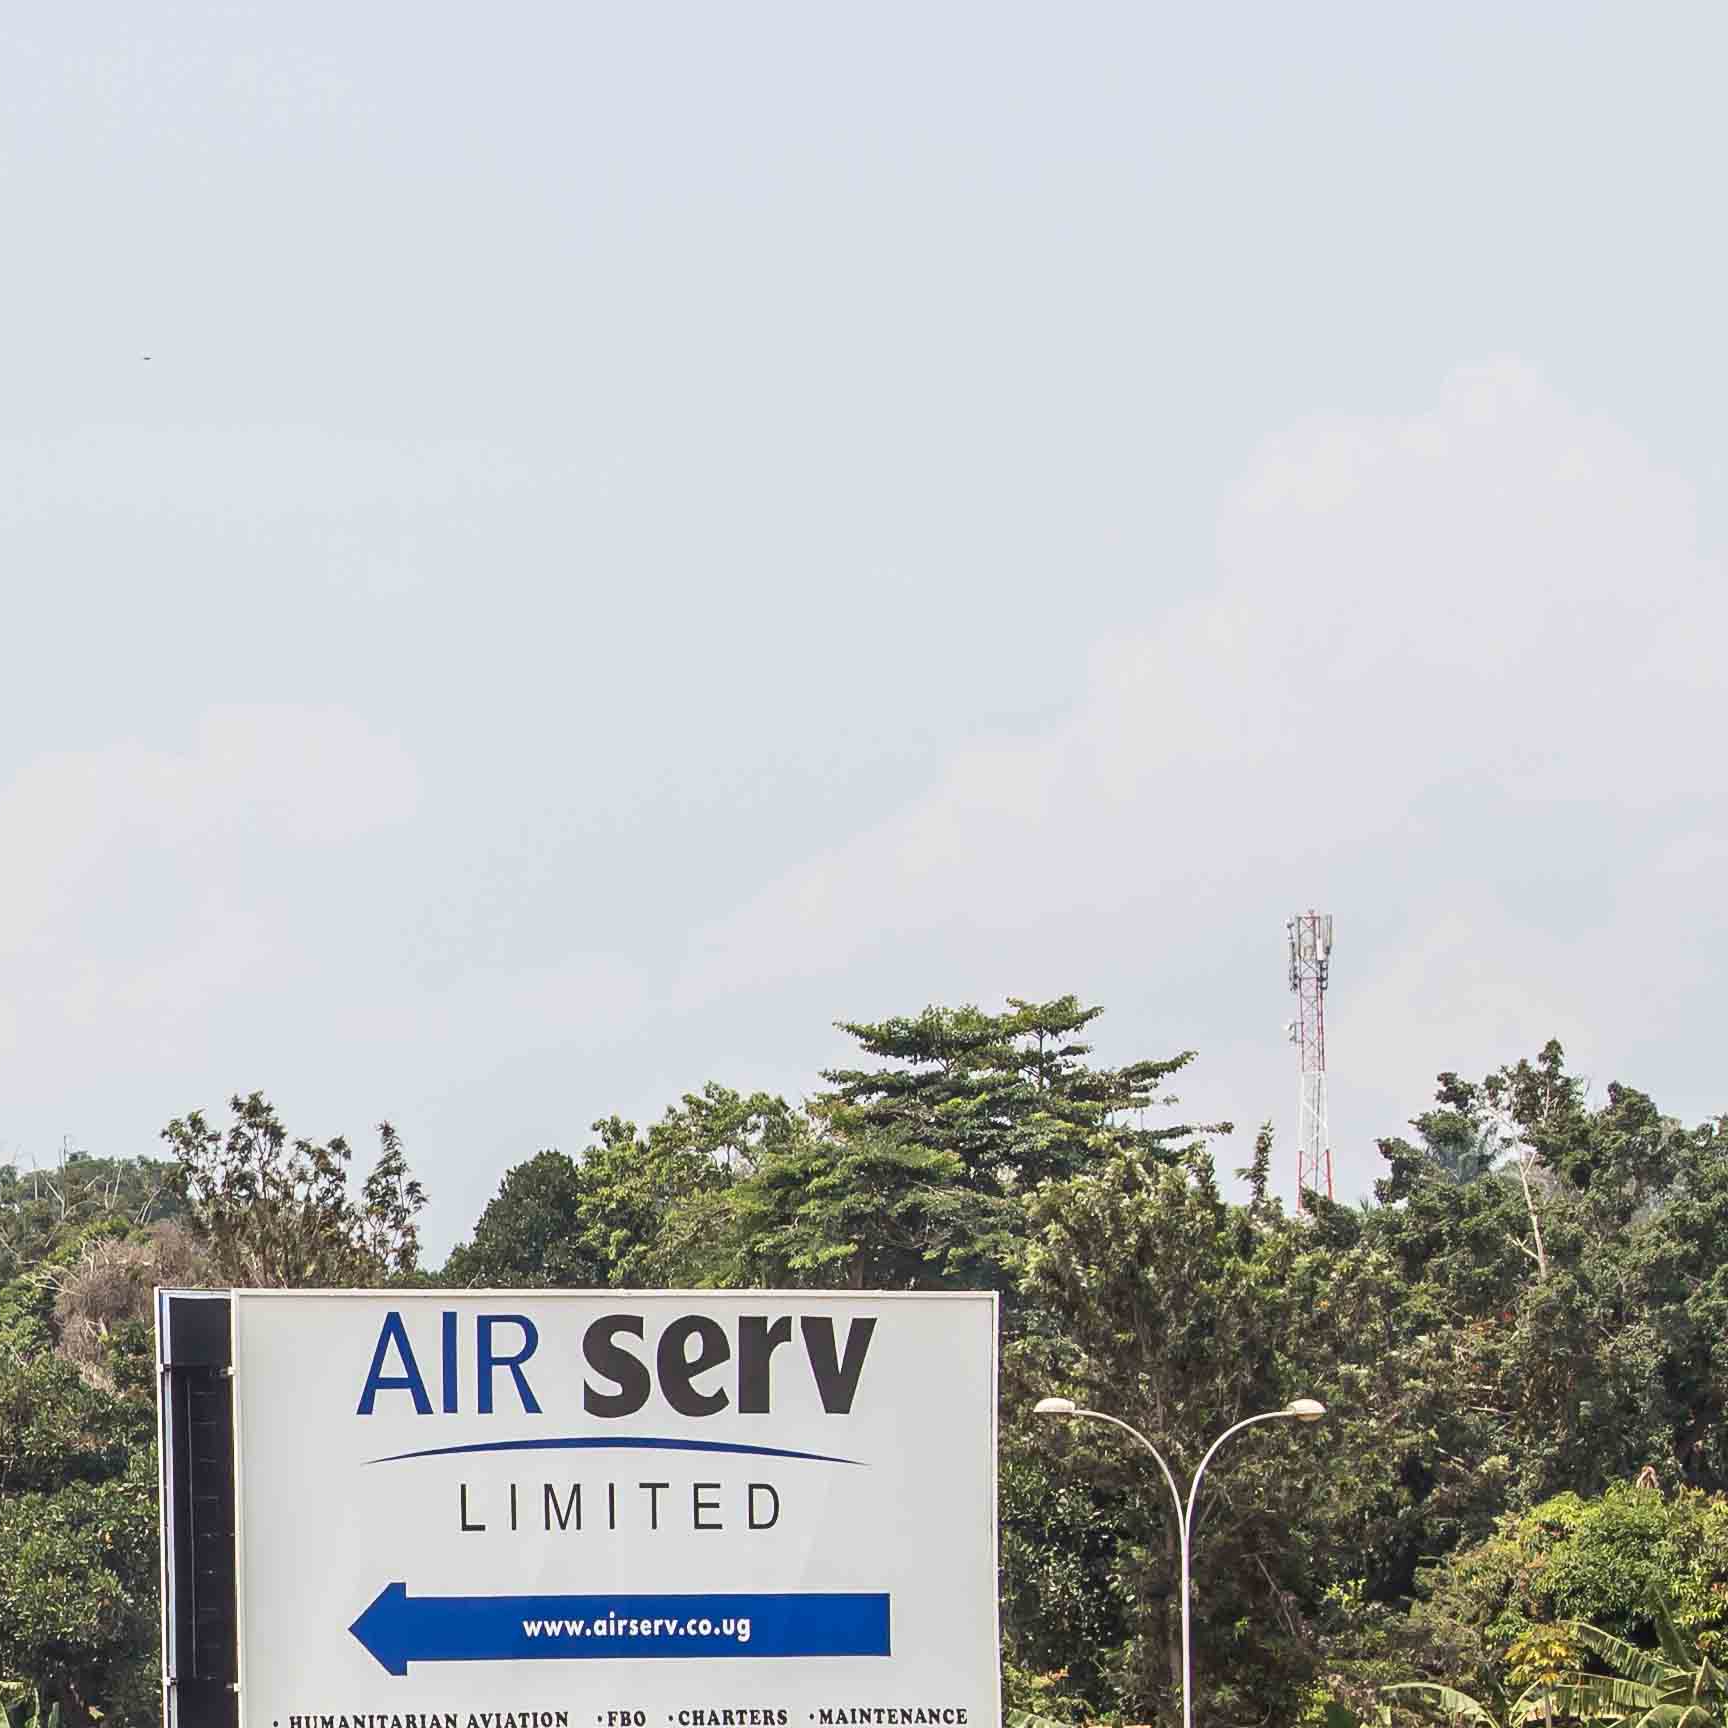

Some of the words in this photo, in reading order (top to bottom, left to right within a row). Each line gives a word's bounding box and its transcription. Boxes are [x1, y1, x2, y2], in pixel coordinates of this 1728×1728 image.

[356, 1310, 543, 1416] AIR
[582, 1313, 878, 1419] serv
[460, 1482, 782, 1531] LIMITED
[522, 1613, 752, 1643] www.airserv.co.ug
[606, 1708, 648, 1728] FBO
[678, 1707, 789, 1728] CHARTERS
[819, 1705, 969, 1727] MAINTENANCE
